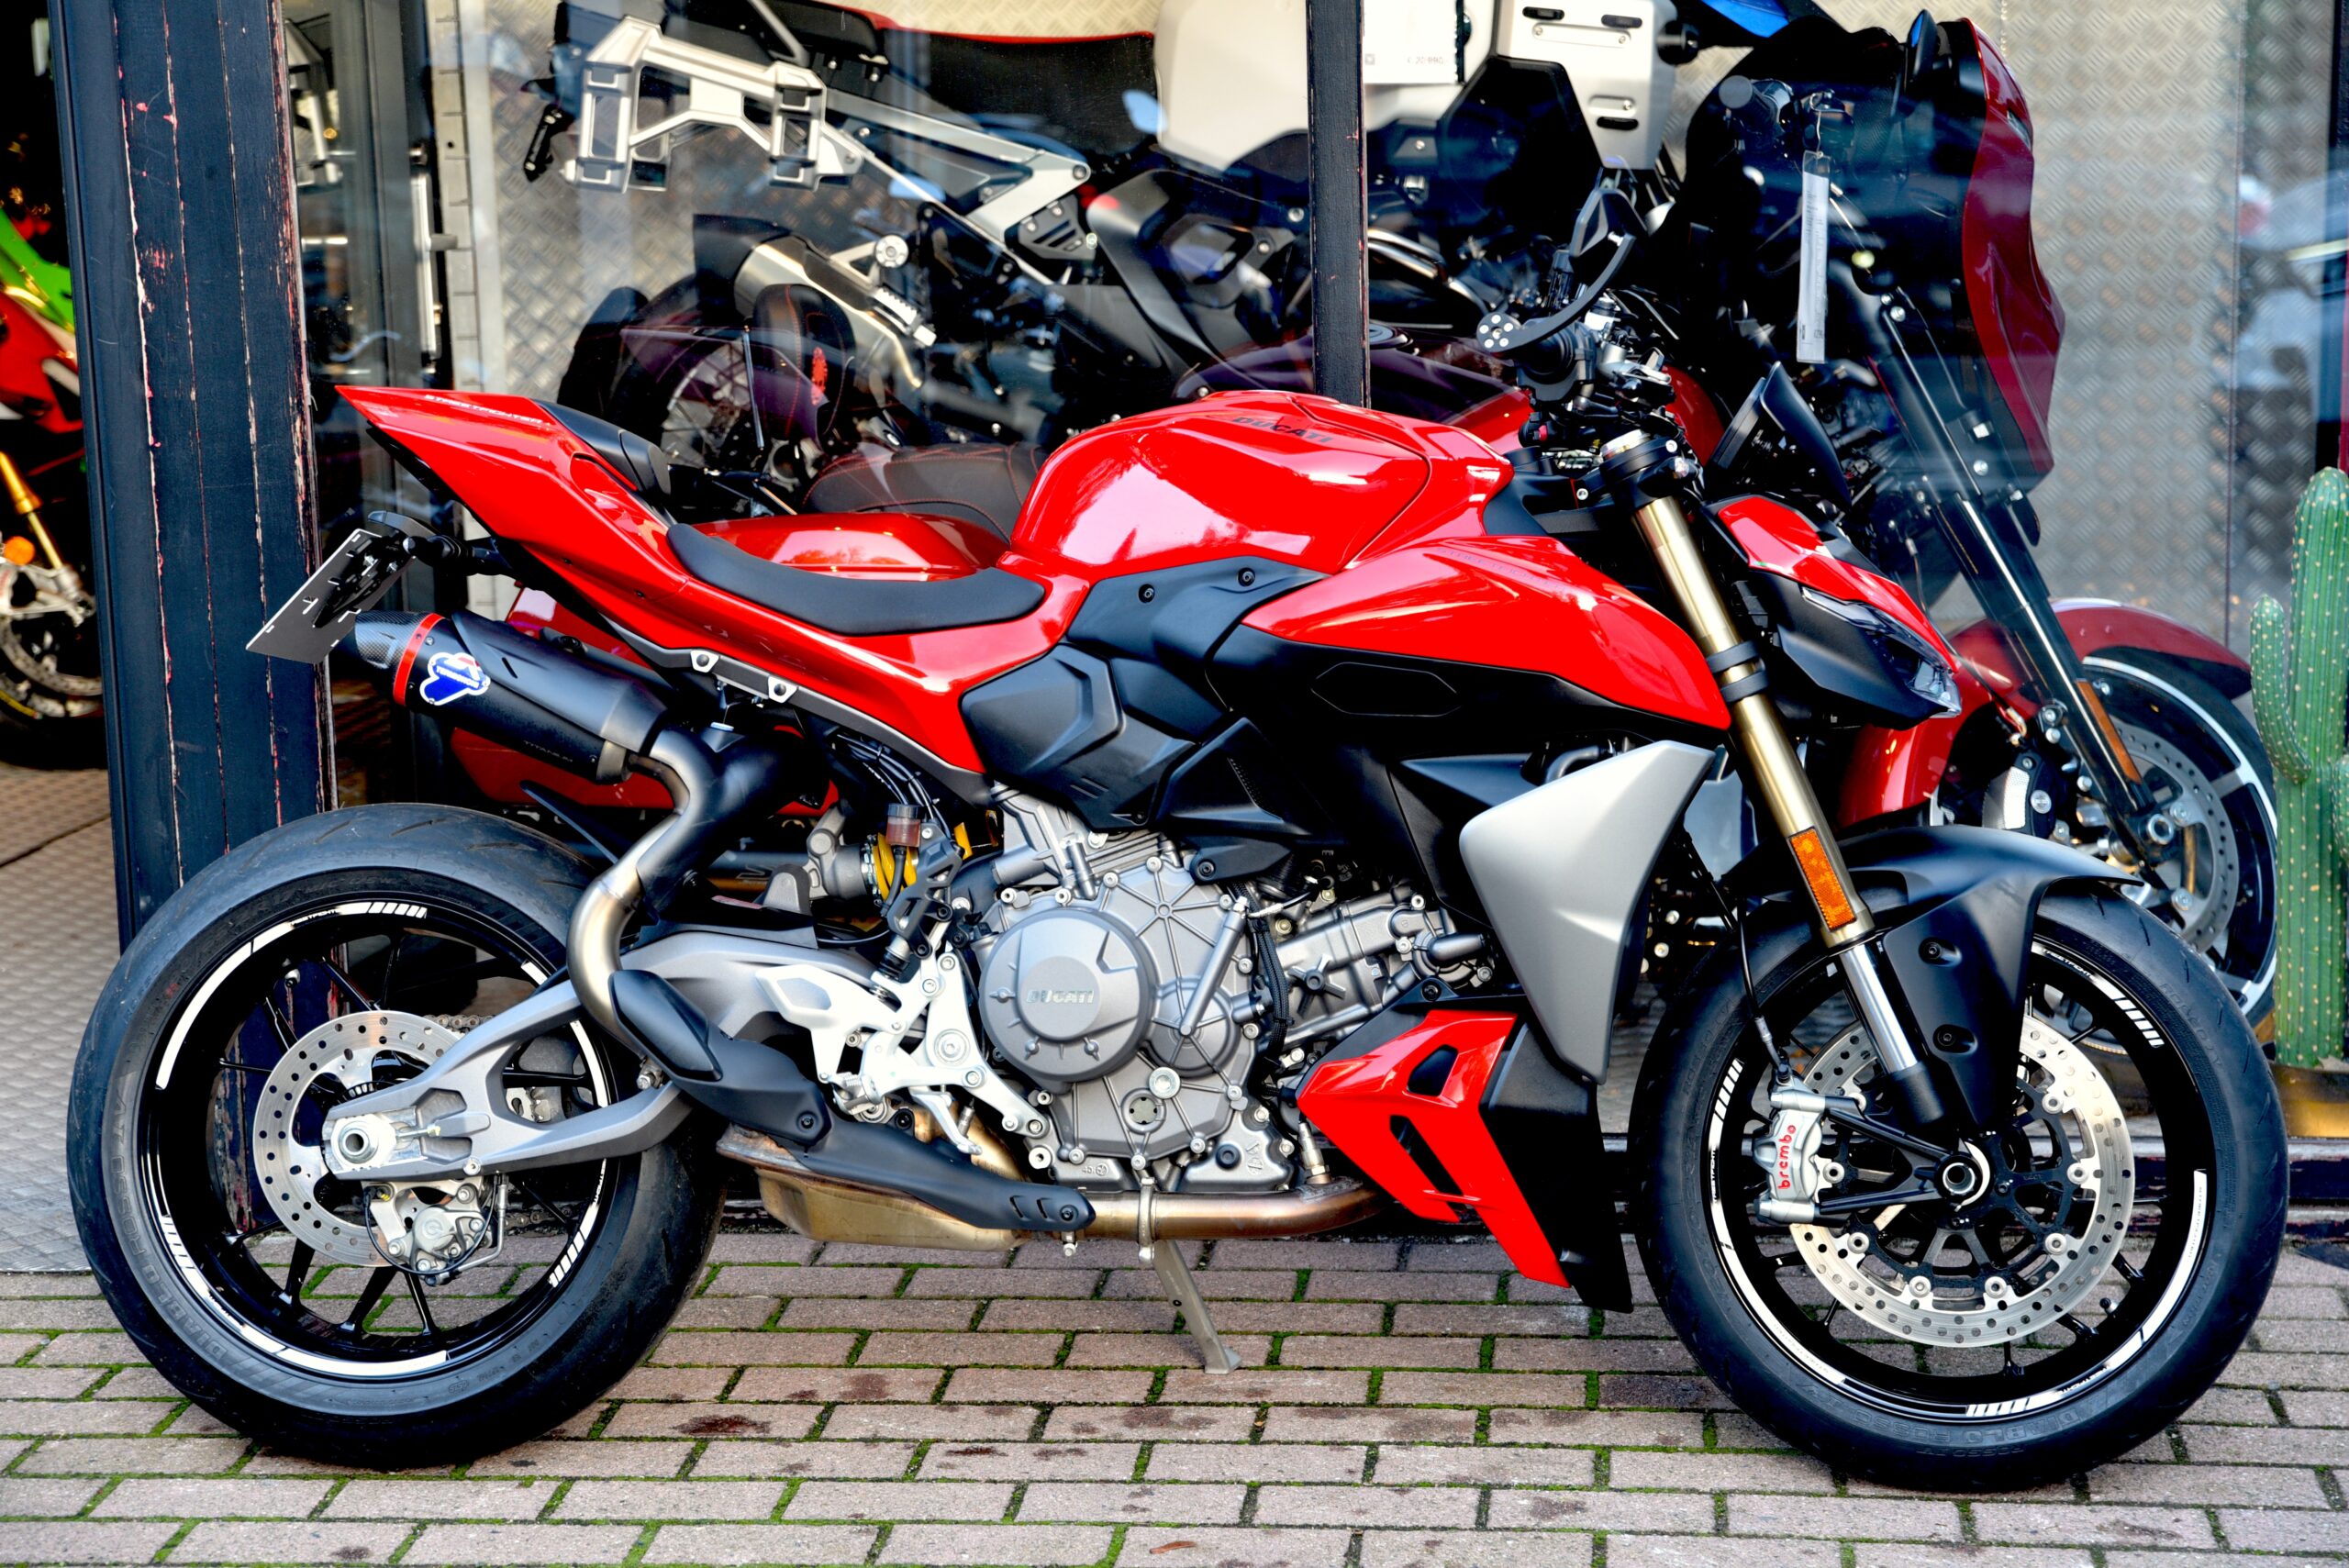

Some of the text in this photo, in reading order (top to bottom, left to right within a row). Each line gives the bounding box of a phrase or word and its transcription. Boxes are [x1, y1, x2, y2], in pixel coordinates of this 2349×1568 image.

[1232, 417, 1333, 443] DUCATI
[1026, 990, 1095, 1004] DUCATI
[1776, 1124, 1797, 1190] brembo
[110, 1155, 147, 1257] ROSSO
[141, 1263, 228, 1360] DIABLO
[1850, 1408, 1952, 1443] ROSSO
[1966, 1407, 2084, 1444] DIABLO
